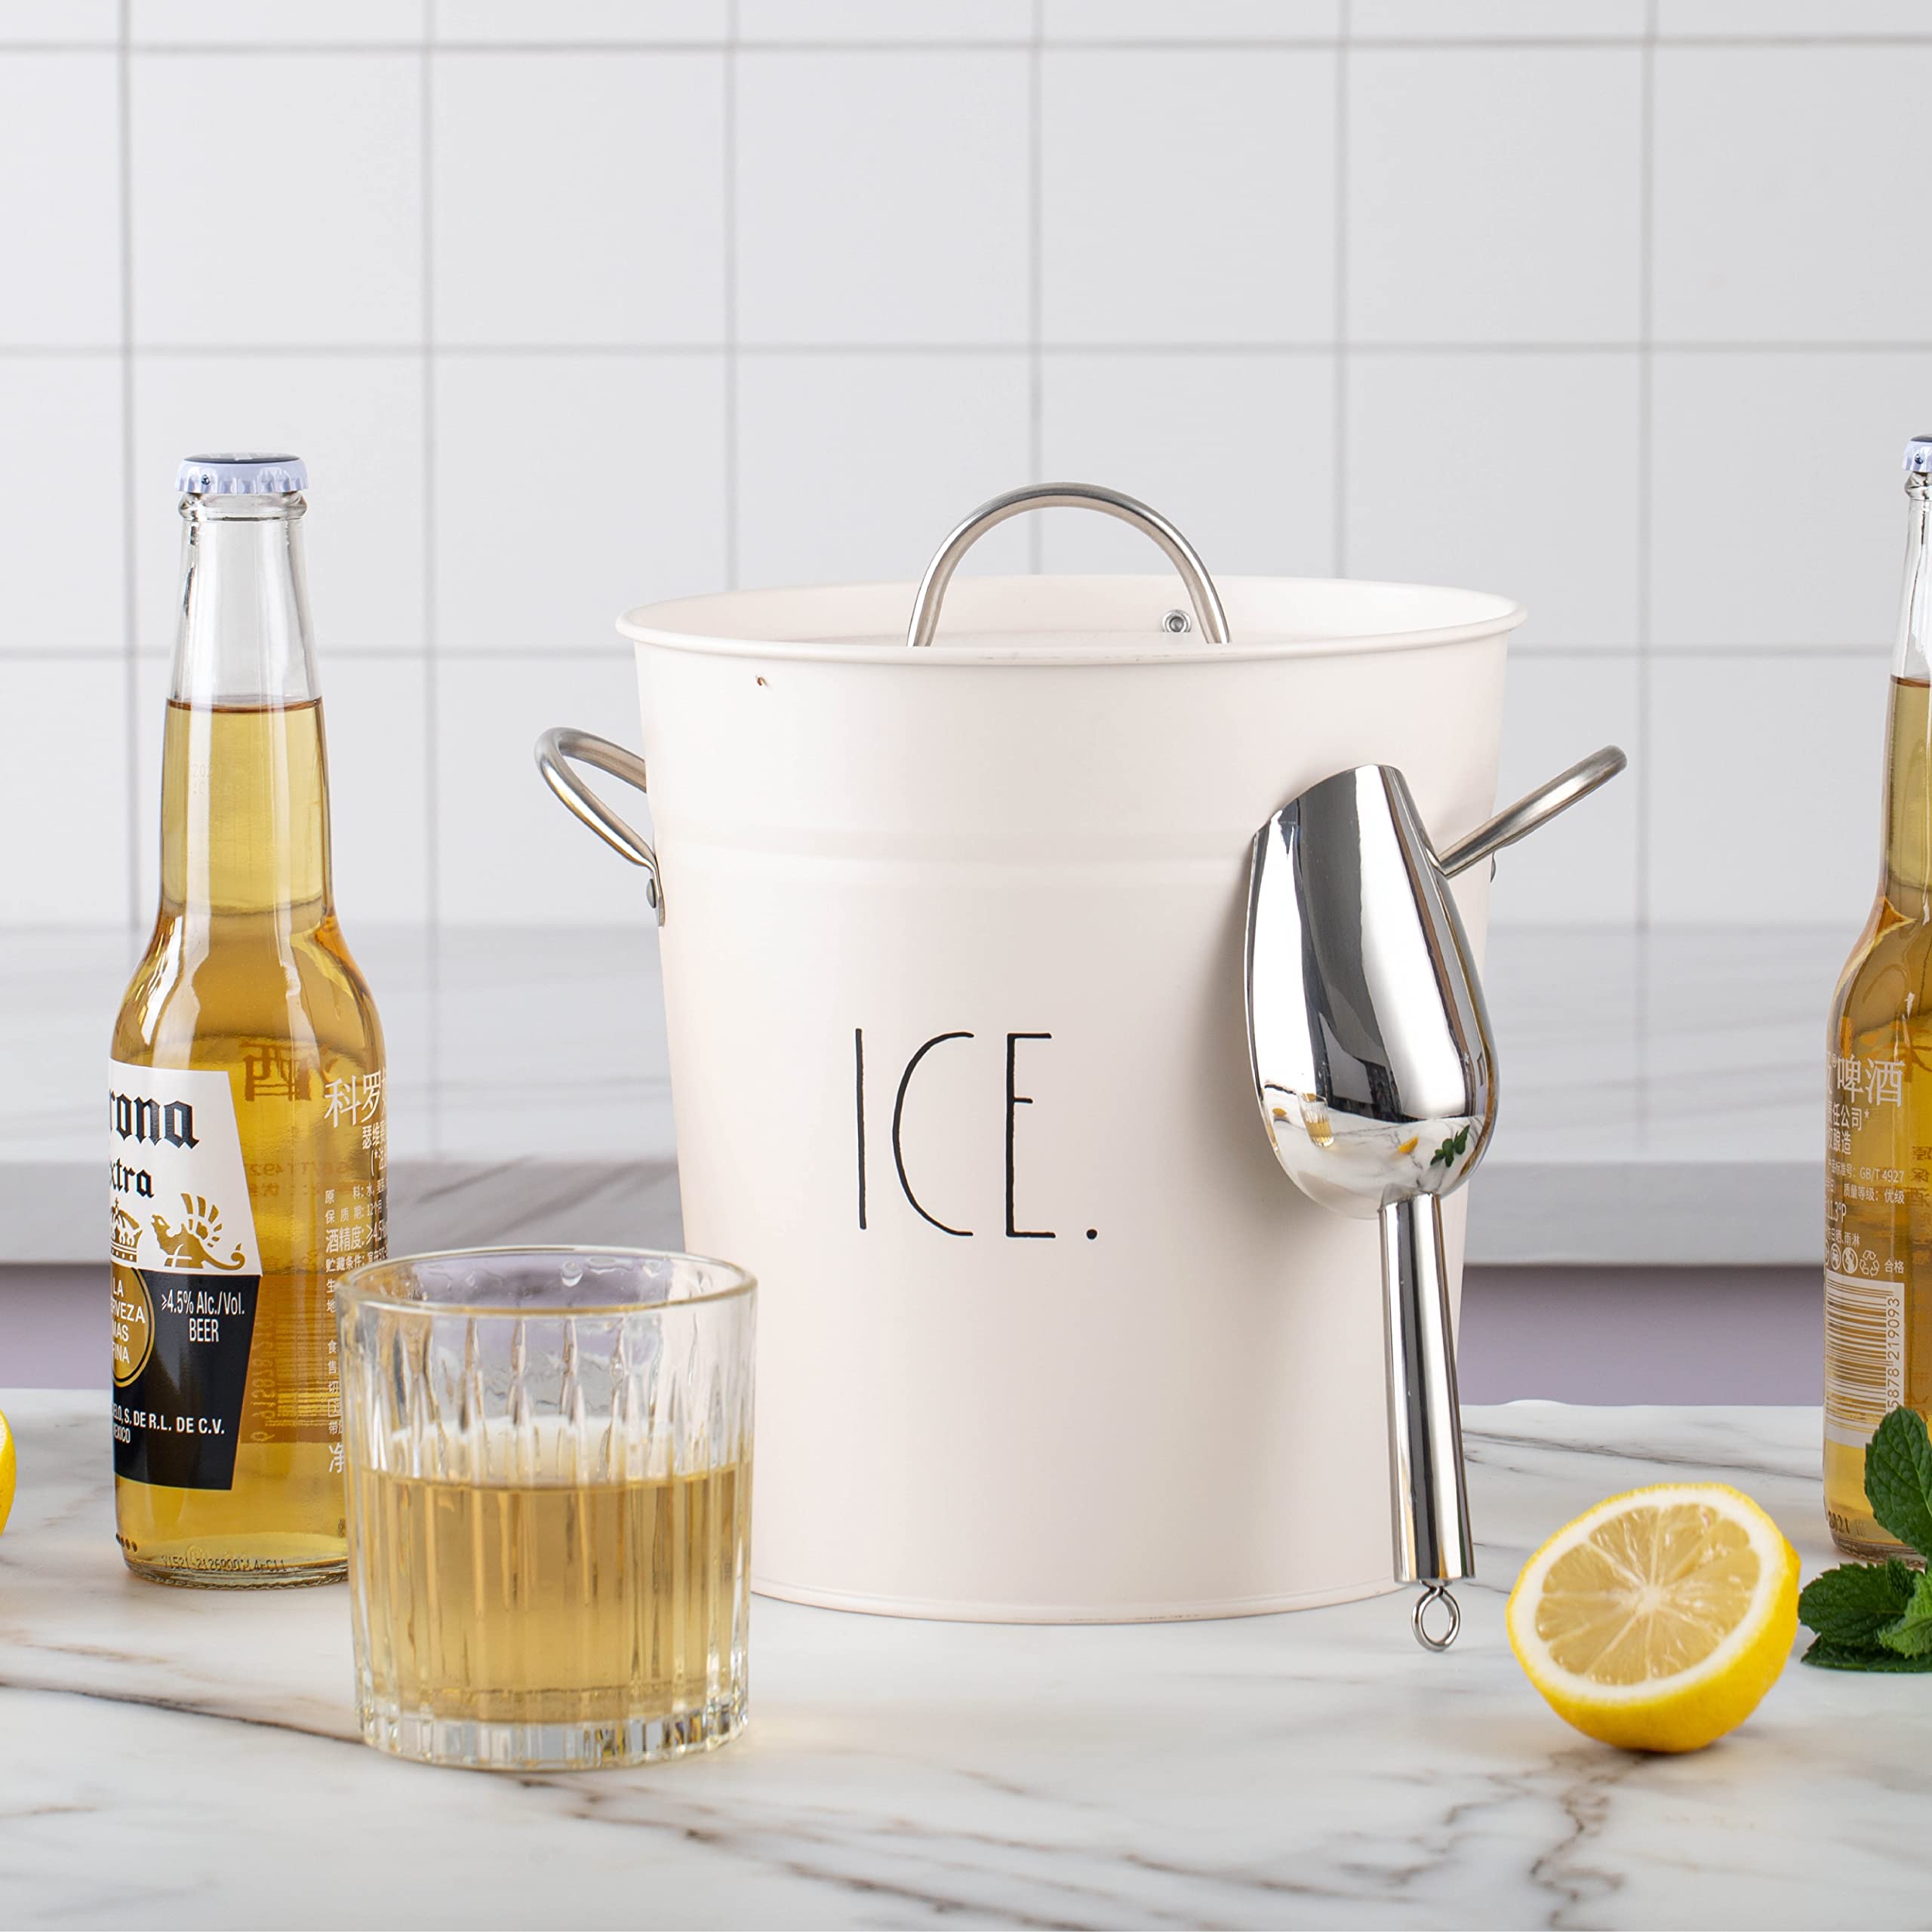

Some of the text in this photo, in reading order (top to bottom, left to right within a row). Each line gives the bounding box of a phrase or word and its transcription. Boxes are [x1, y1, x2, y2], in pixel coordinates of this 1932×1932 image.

[855, 1028, 1098, 1238] ICE.
[1882, 1170, 1905, 1183] 4927
[1884, 1260, 1905, 1275] 合格
[189, 1318, 220, 1343] BEER
[1887, 1297, 1900, 1361] 219093
[133, 1410, 146, 1429] DE
[149, 1412, 172, 1432] R.L.
[176, 1416, 195, 1434] DE
[198, 1417, 226, 1435] C.V.
